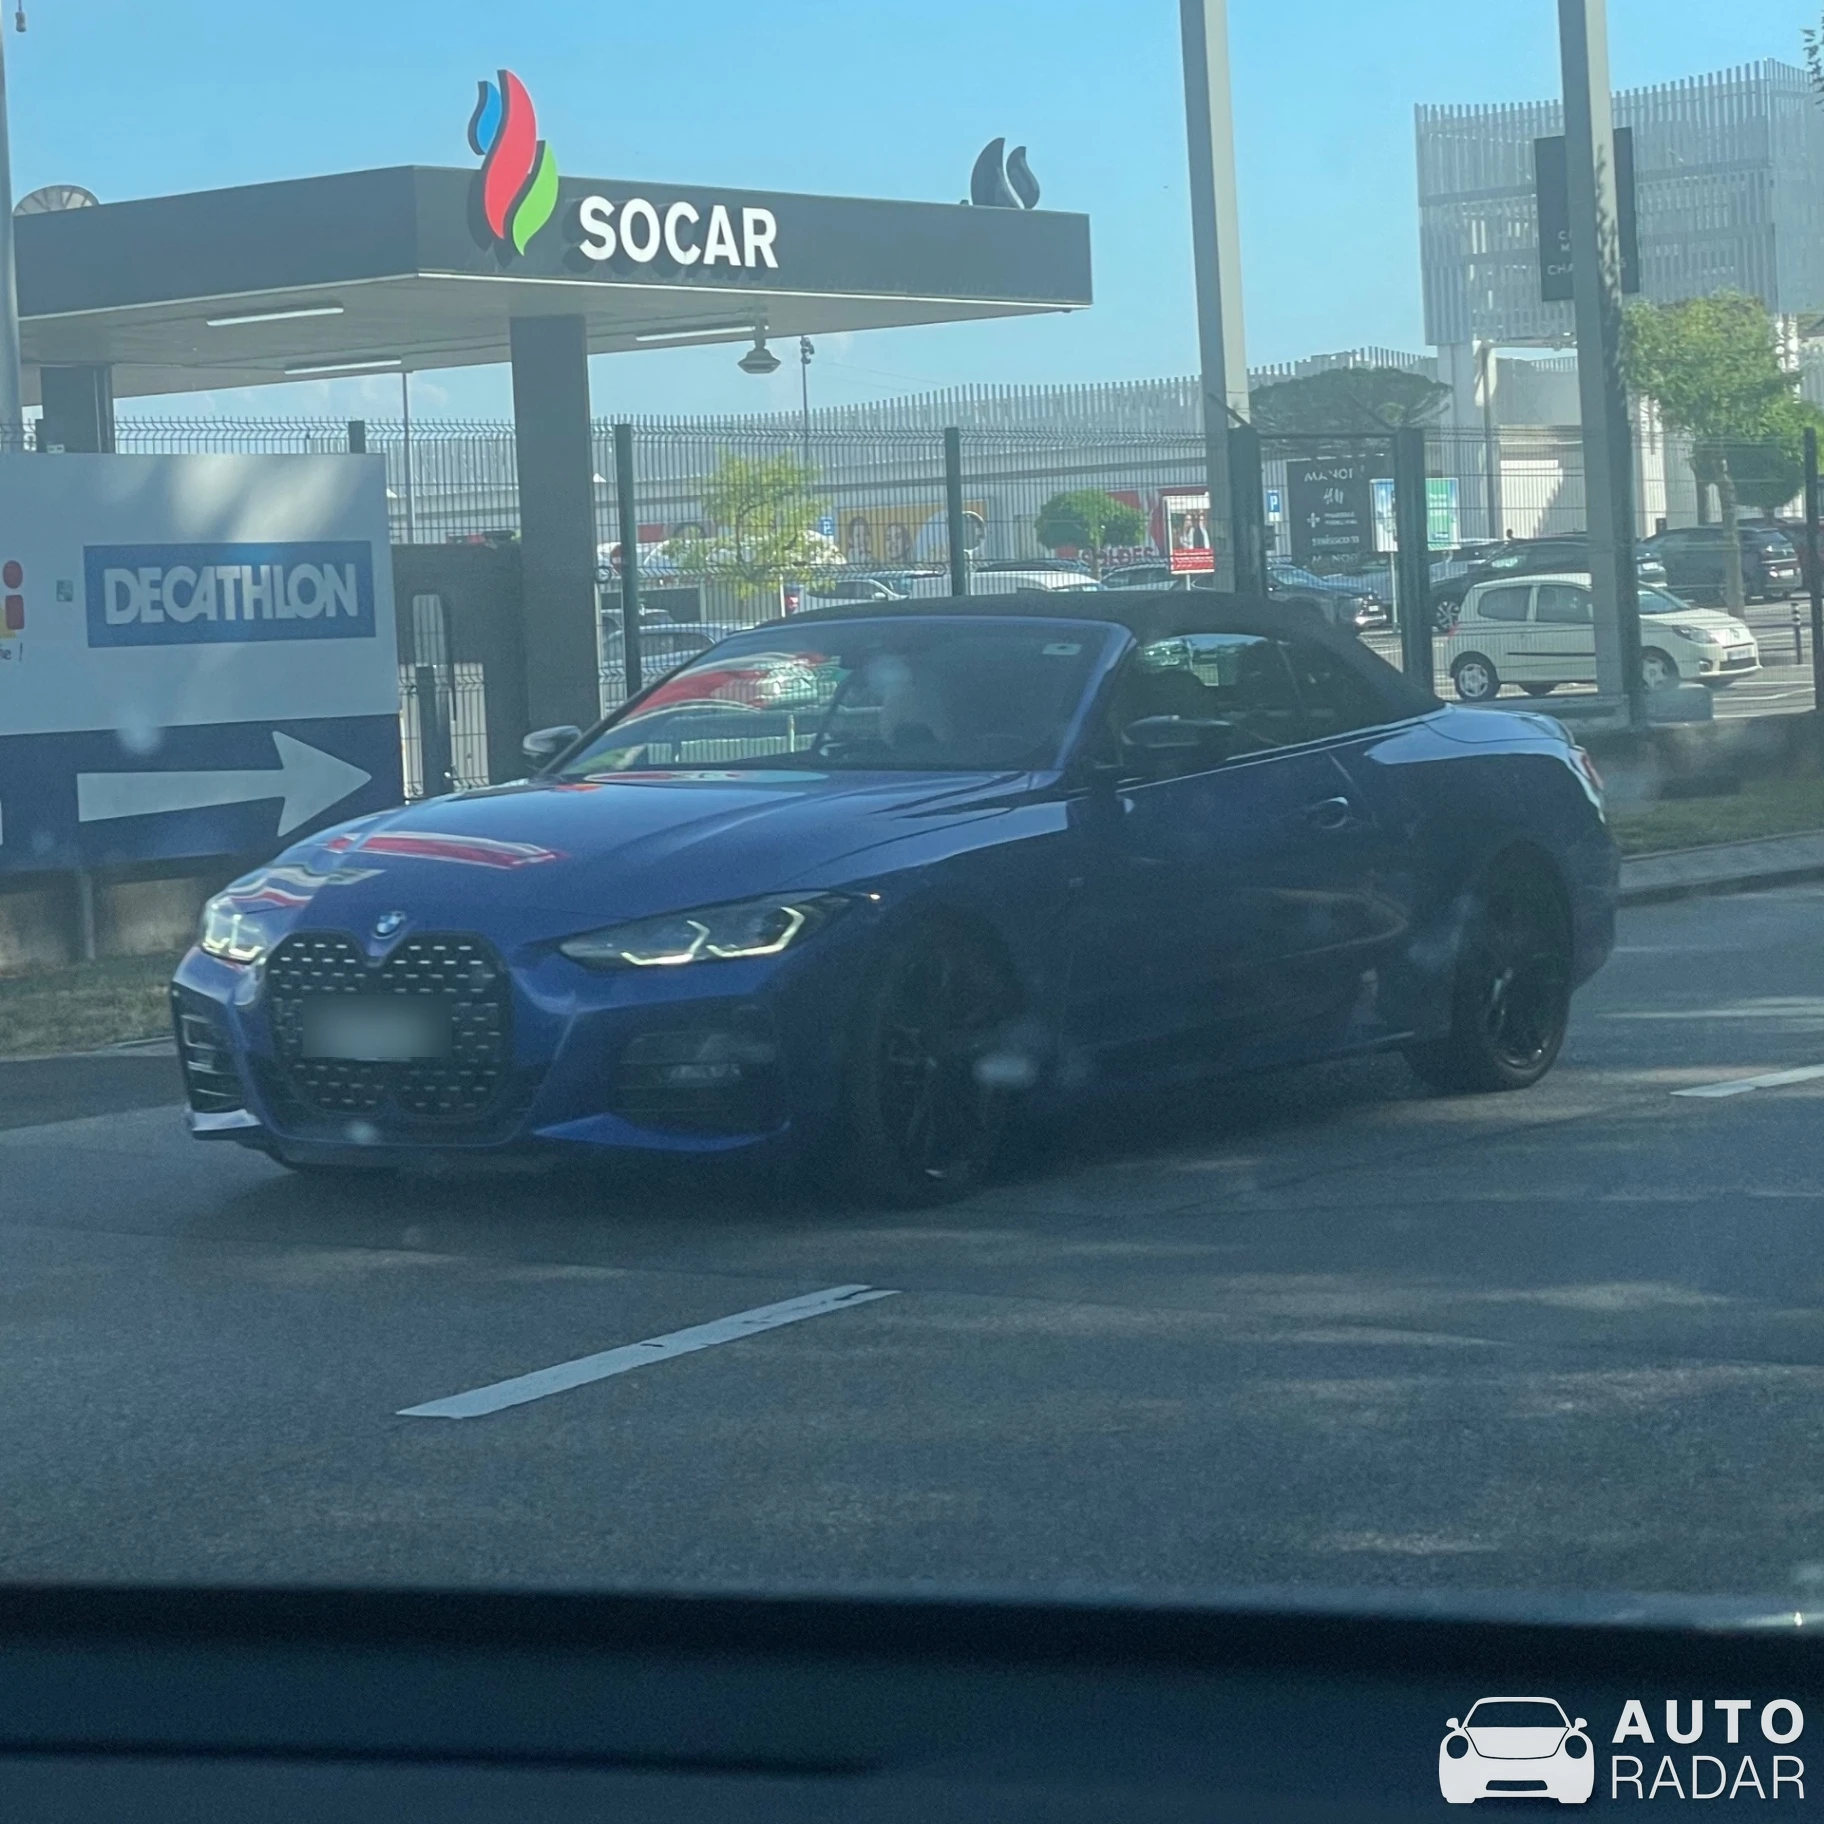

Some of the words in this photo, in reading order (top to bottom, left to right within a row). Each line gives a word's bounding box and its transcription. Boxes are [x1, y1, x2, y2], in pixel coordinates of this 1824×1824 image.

[579, 195, 779, 268] SOCAR
[1269, 495, 1278, 511] P
[103, 563, 358, 625] DECATHLON
